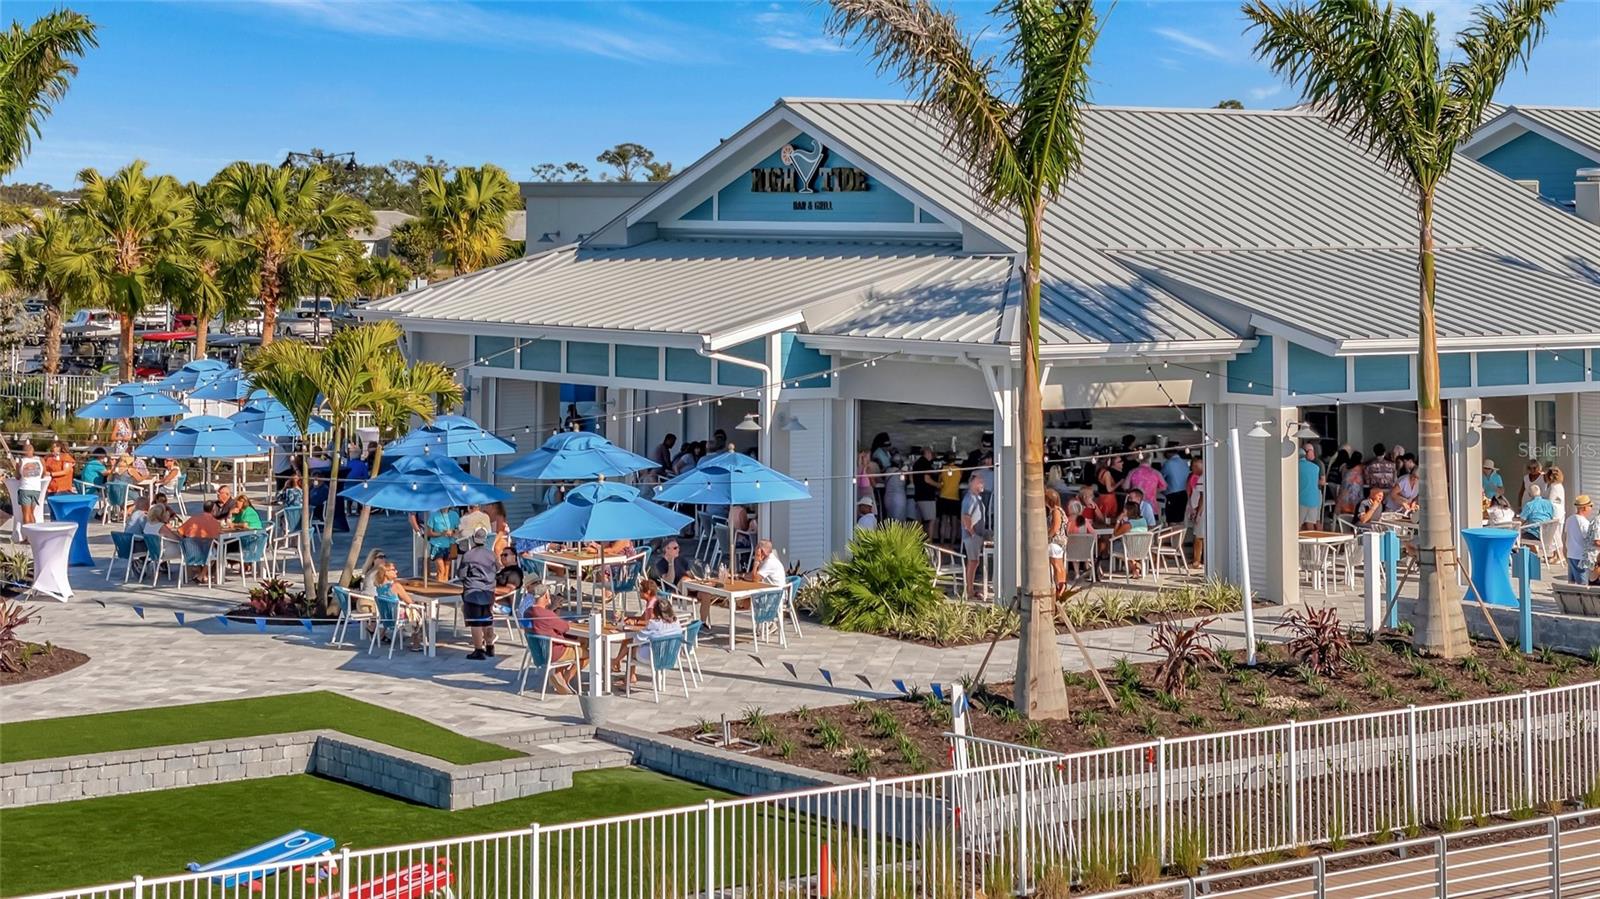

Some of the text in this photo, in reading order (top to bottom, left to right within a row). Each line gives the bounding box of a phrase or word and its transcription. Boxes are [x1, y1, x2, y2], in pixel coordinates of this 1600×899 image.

[751, 168, 867, 192] HIGH TIDE
[793, 201, 833, 210] BAR & GRILL
